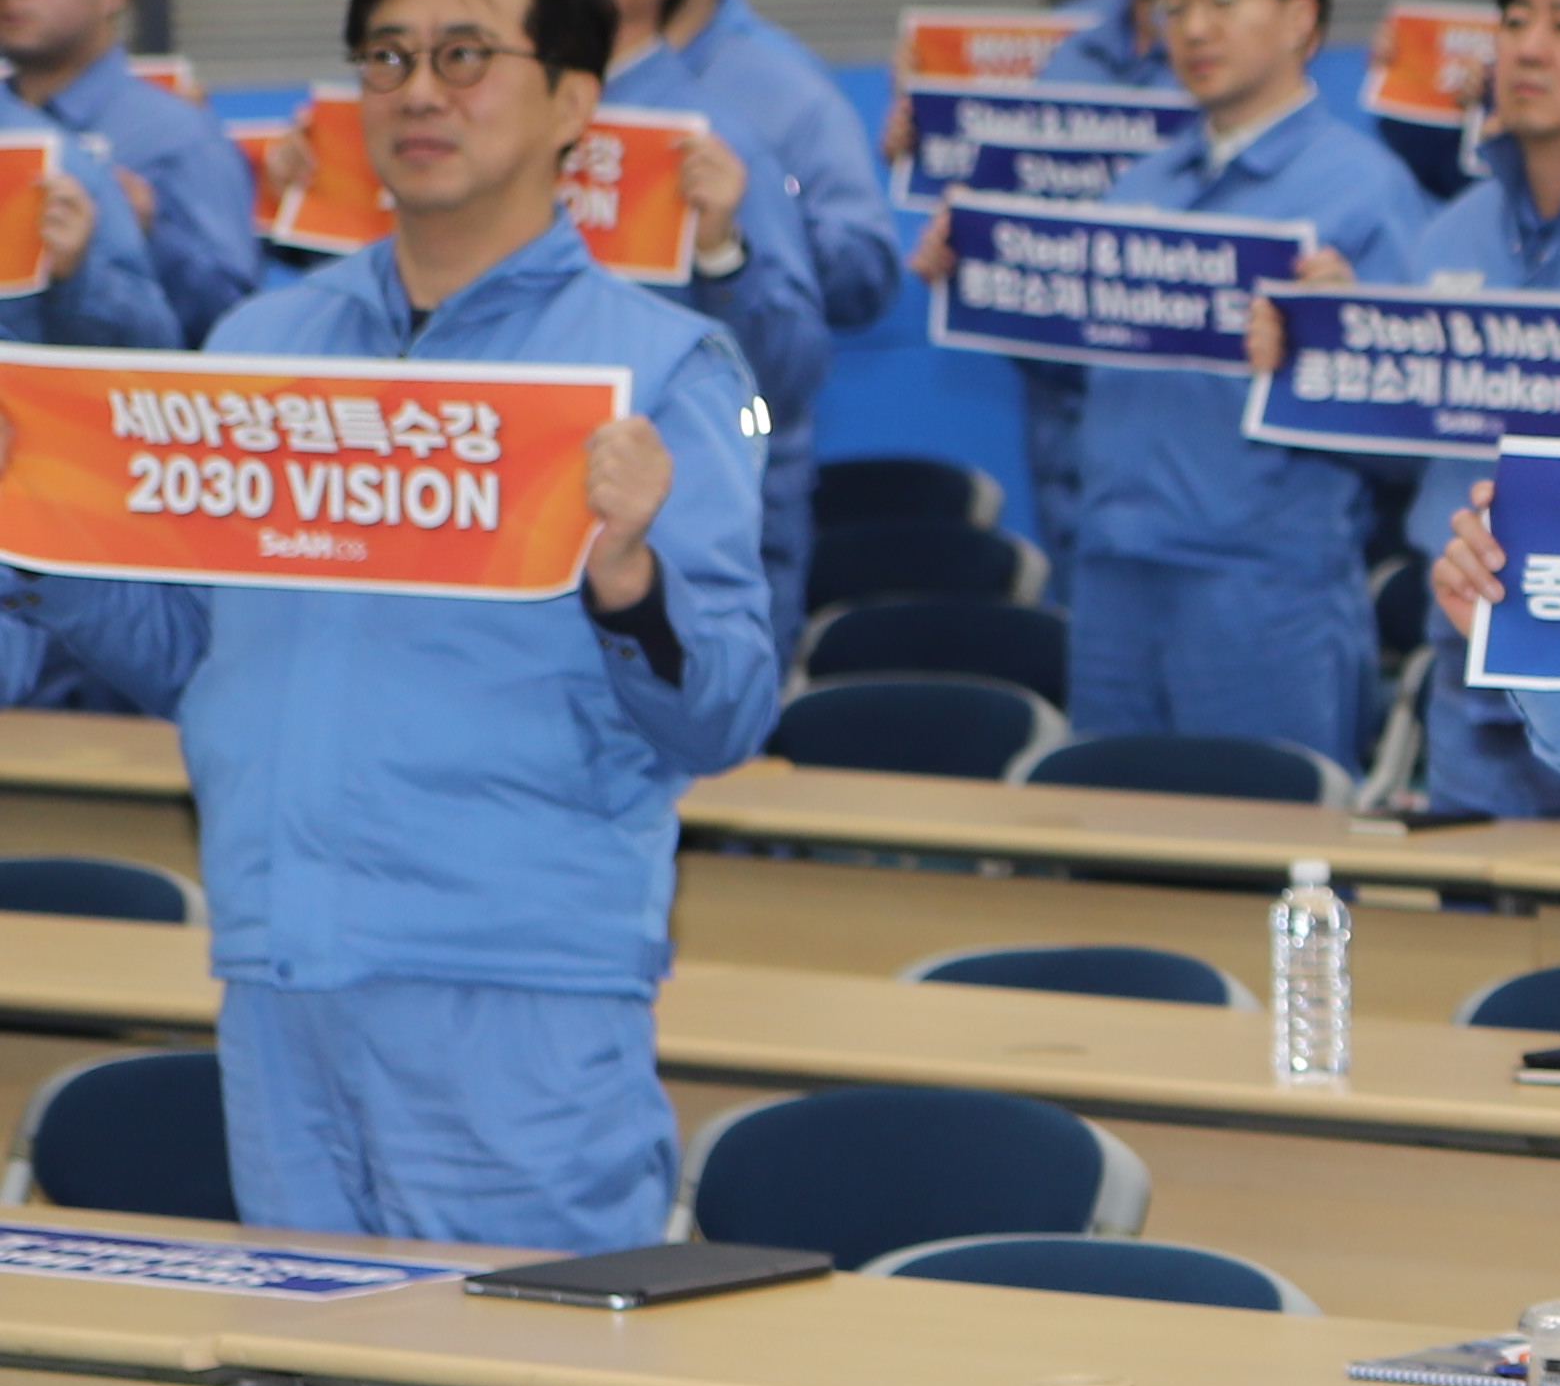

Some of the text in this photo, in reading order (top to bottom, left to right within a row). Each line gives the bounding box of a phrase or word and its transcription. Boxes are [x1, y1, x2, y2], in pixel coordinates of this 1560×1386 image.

[992, 221, 1088, 271] Steel
[1125, 234, 1237, 287] Metal
[1091, 277, 1208, 331] Maker
[1340, 303, 1446, 353] Steel
[1449, 310, 1482, 358] &
[109, 388, 501, 464] 세아창원특수강
[126, 451, 499, 532] 2030 VISION
